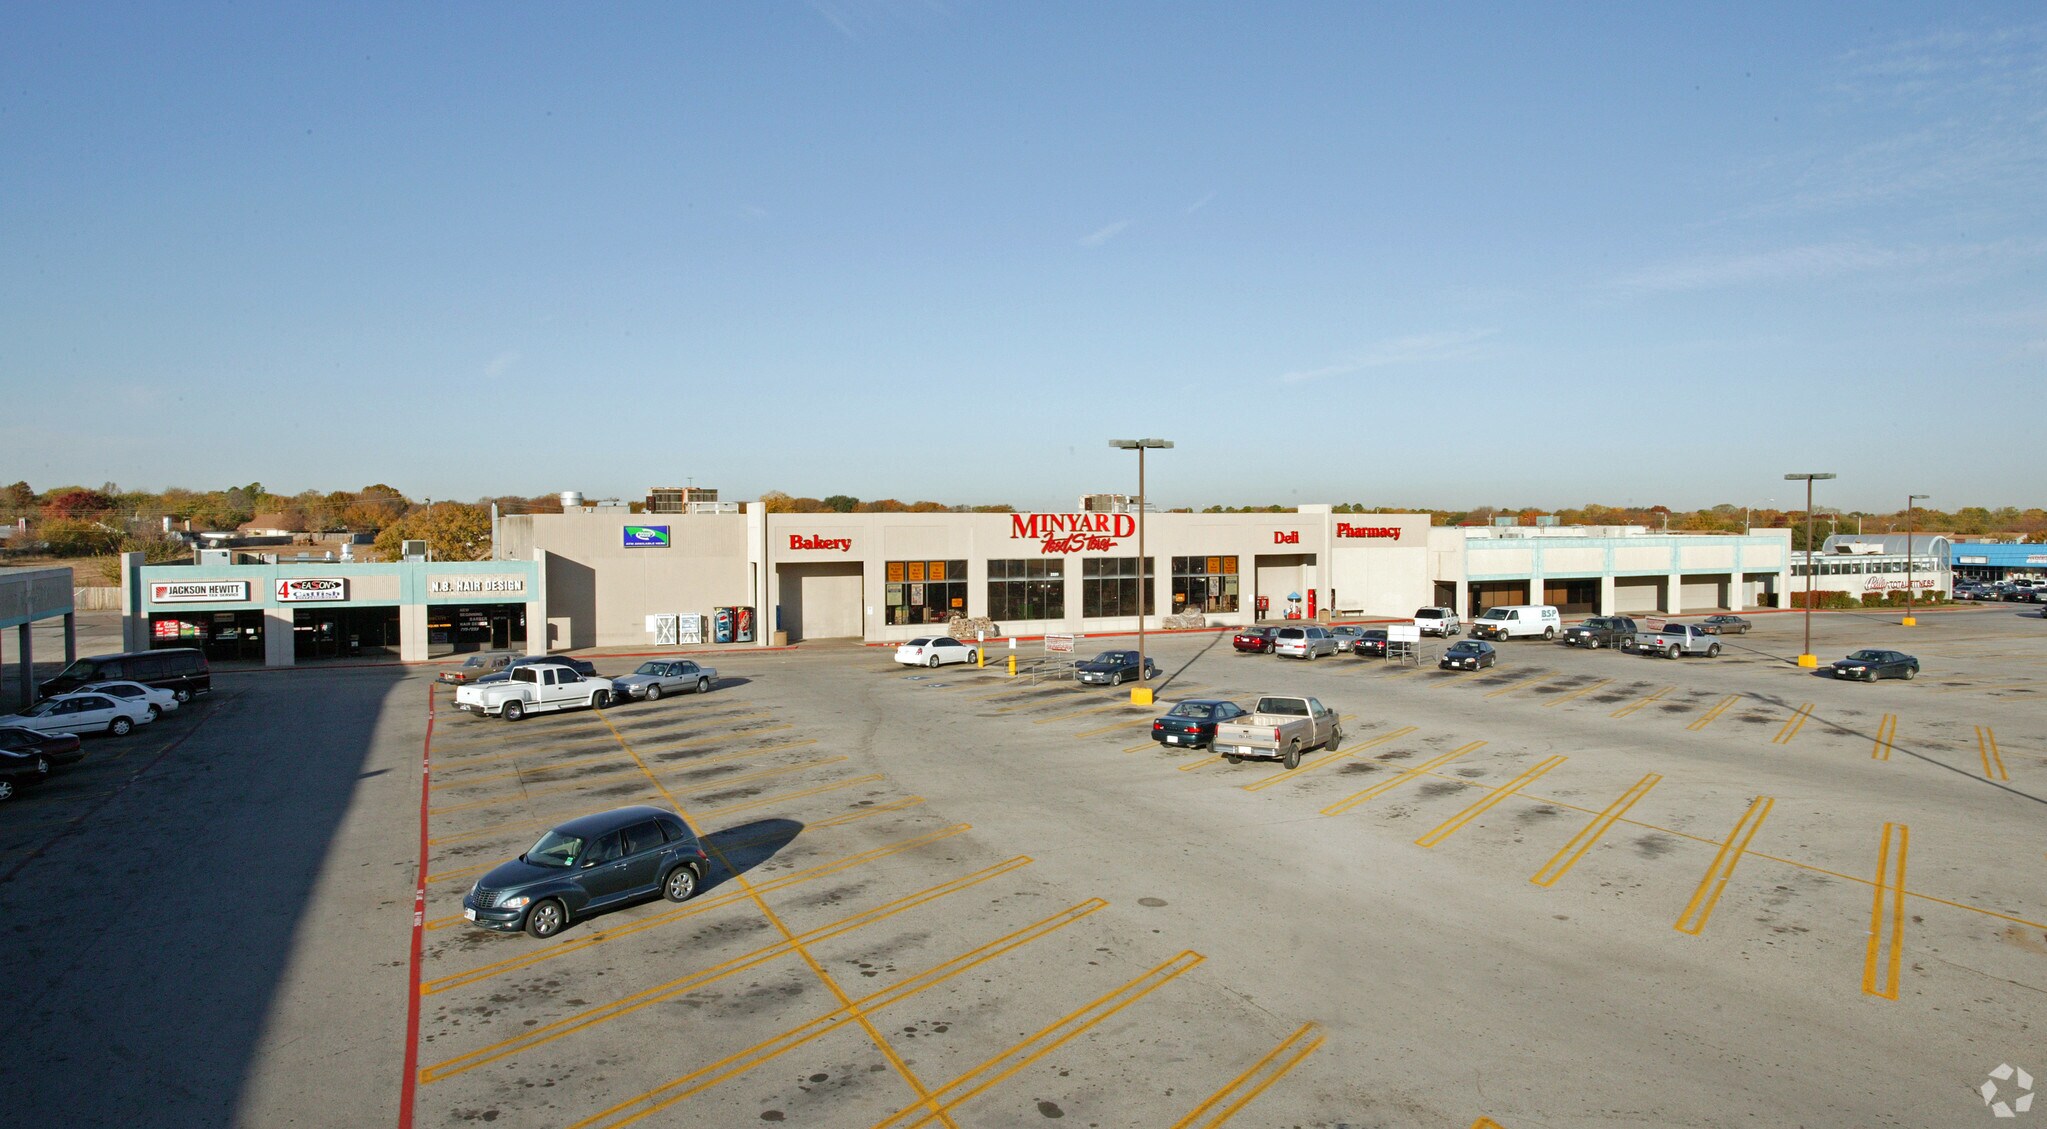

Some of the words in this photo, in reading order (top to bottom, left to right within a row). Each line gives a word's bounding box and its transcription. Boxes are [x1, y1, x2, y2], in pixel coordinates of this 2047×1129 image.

[1010, 514, 1136, 538] MINYARD
[1336, 522, 1402, 541] Pharmacy
[789, 534, 852, 552] Bakery
[1040, 531, 1072, 555] Food
[1273, 531, 1300, 544] Deli
[169, 586, 207, 595] JACKSON
[209, 585, 240, 594] HEWITT
[278, 581, 290, 599] 4
[292, 580, 336, 590] SEASON'S
[432, 581, 454, 592] N.B.
[457, 581, 482, 592] HAIR
[485, 580, 523, 592] DESIGN
